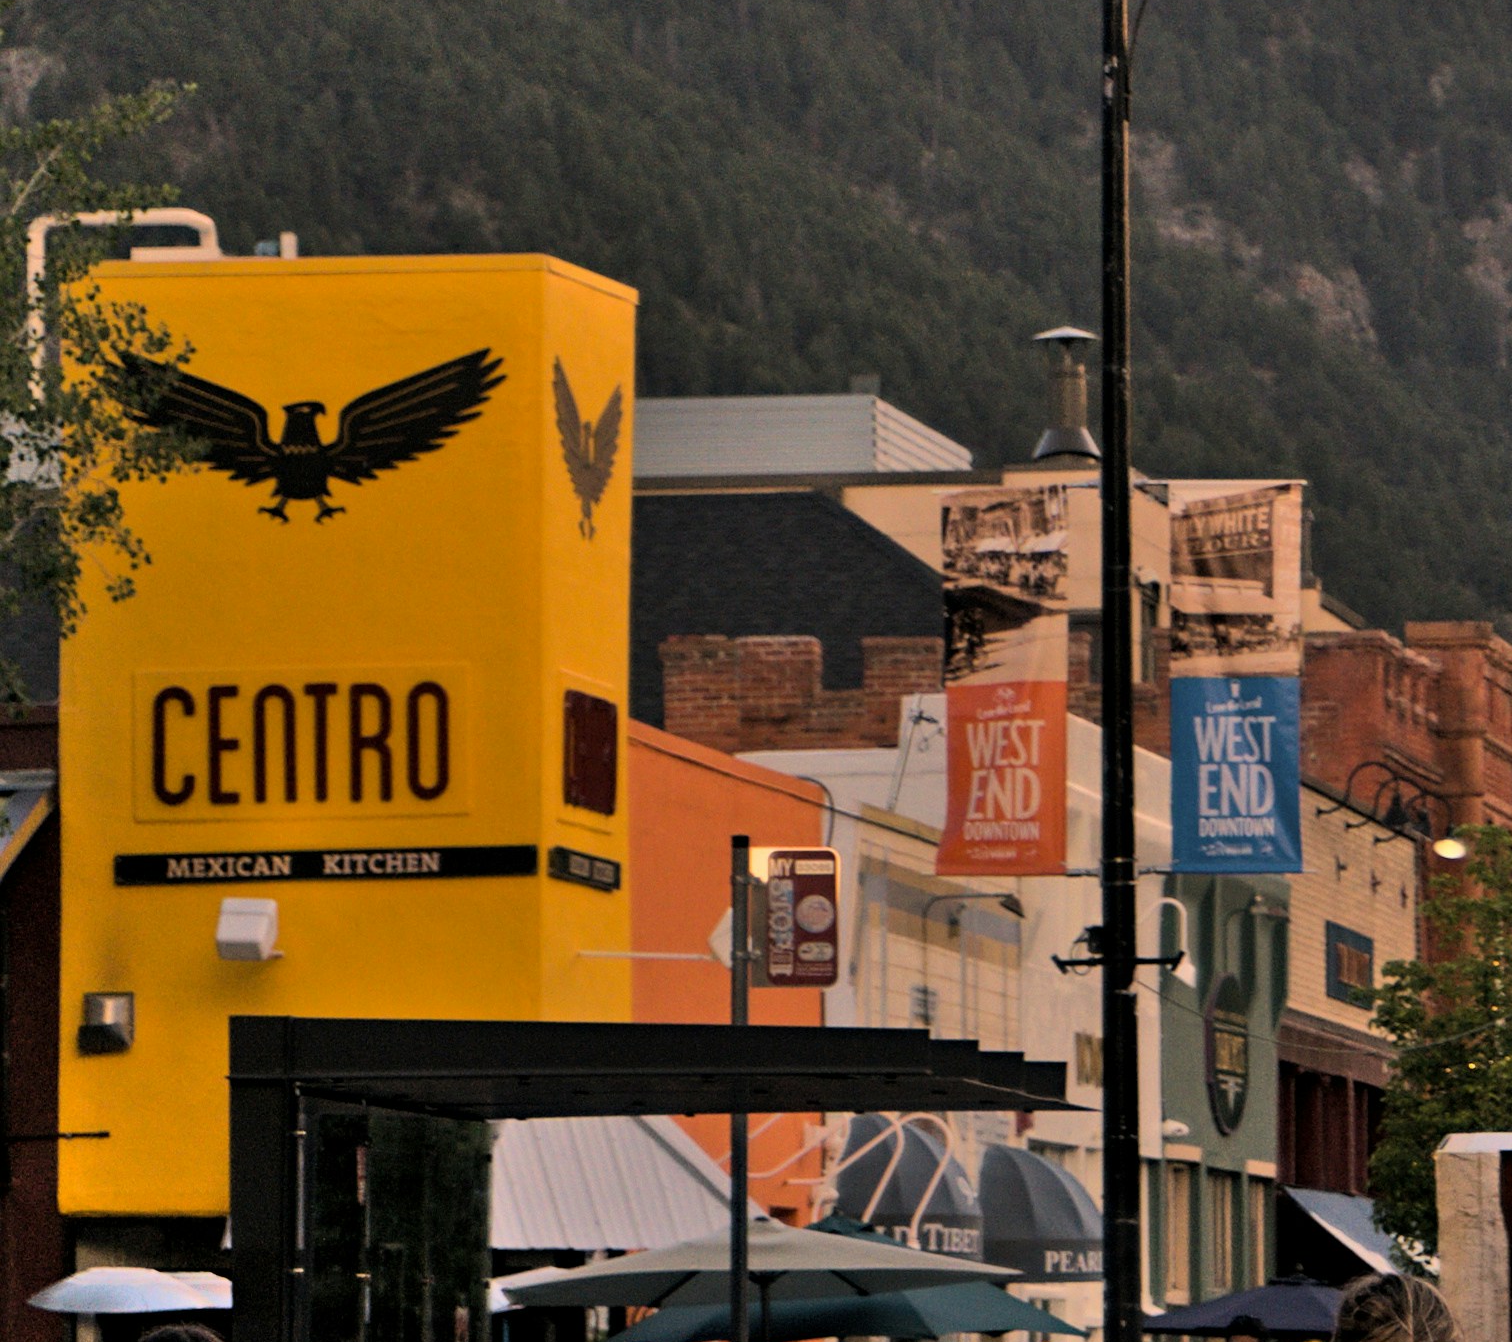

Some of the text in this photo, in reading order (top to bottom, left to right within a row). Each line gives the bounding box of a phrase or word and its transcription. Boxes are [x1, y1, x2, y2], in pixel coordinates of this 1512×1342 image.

[152, 680, 450, 806] CENTRO
[966, 719, 1045, 768] WEST
[1193, 716, 1277, 762] WEST
[966, 767, 1042, 820] END
[1199, 764, 1275, 816] END
[963, 821, 1040, 841] DOWNTOWN
[1198, 817, 1275, 838] DOWNTOWN
[167, 852, 441, 880] MEXICAN KITCHEN
[1045, 1250, 1103, 1274] PEAR
